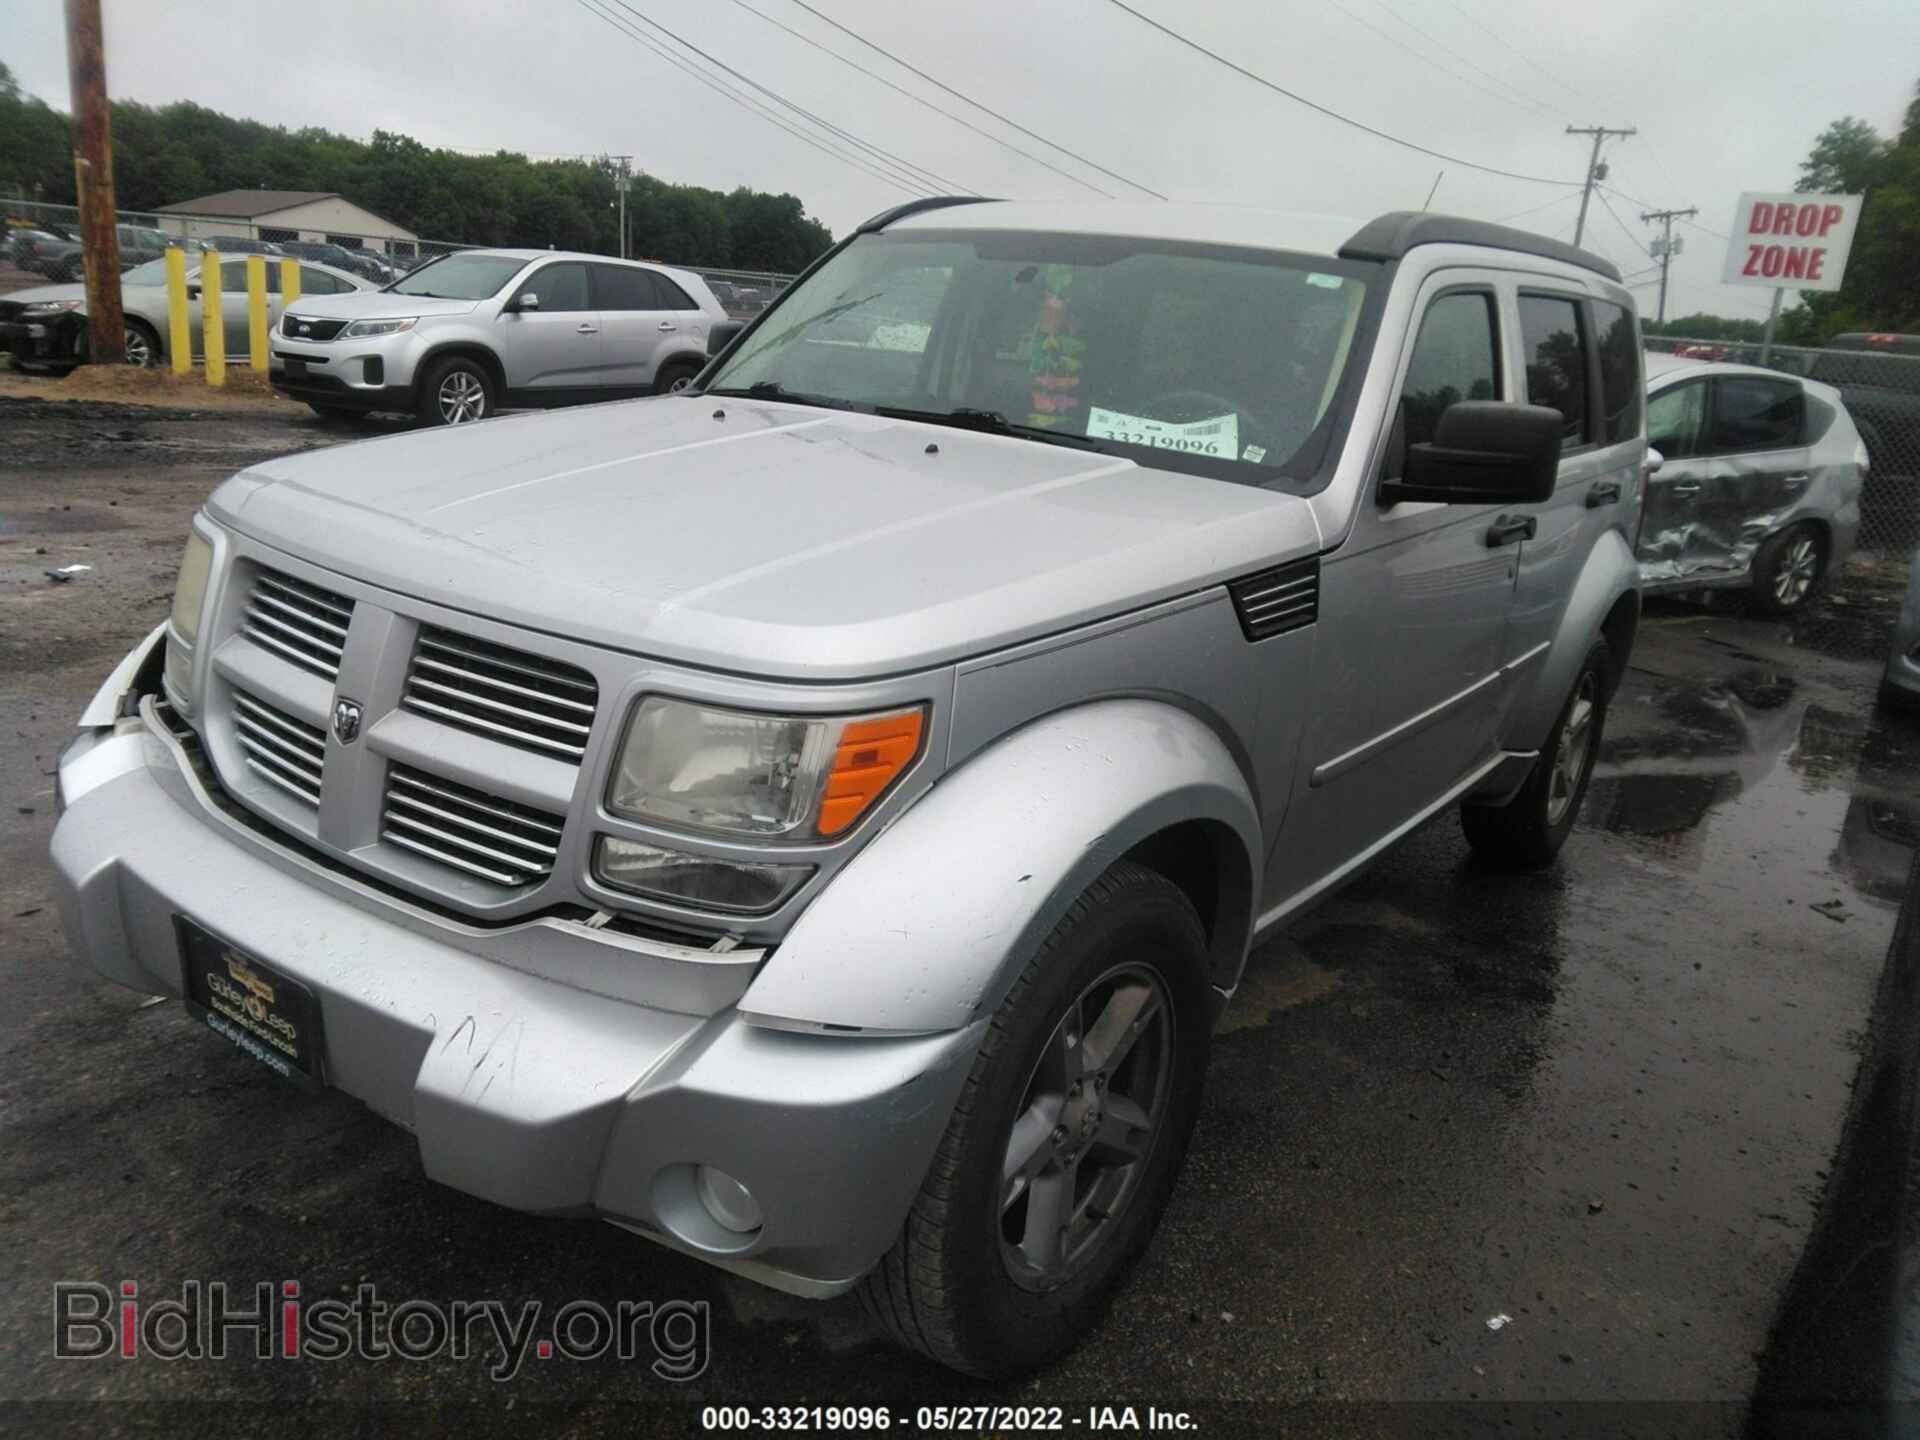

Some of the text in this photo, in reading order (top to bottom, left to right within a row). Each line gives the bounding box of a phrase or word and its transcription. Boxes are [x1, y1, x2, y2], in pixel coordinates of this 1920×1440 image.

[1747, 201, 1844, 237] DROP
[1742, 244, 1827, 280] ZONE
[1103, 430, 1219, 455] 33219096
